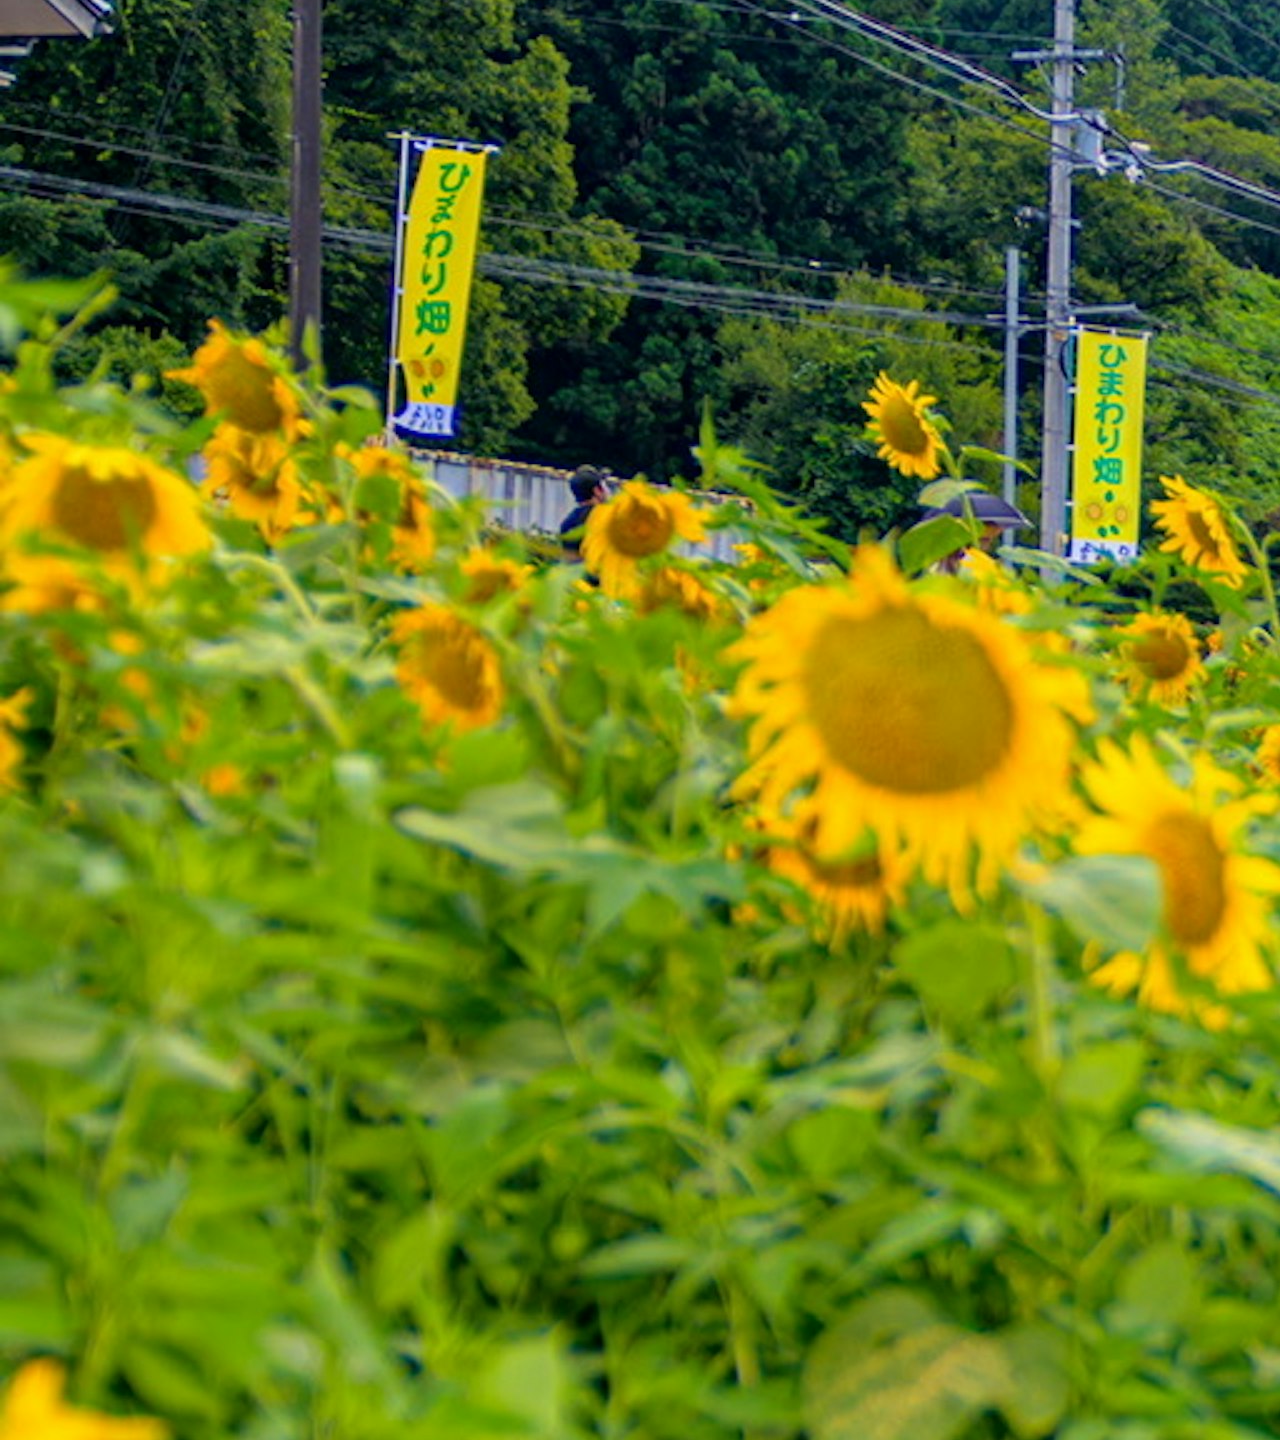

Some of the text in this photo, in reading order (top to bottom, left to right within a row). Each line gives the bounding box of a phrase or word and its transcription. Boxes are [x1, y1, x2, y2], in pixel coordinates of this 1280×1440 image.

[415, 162, 472, 337] ひまわり畑
[1092, 344, 1128, 485] ひまわり畑
